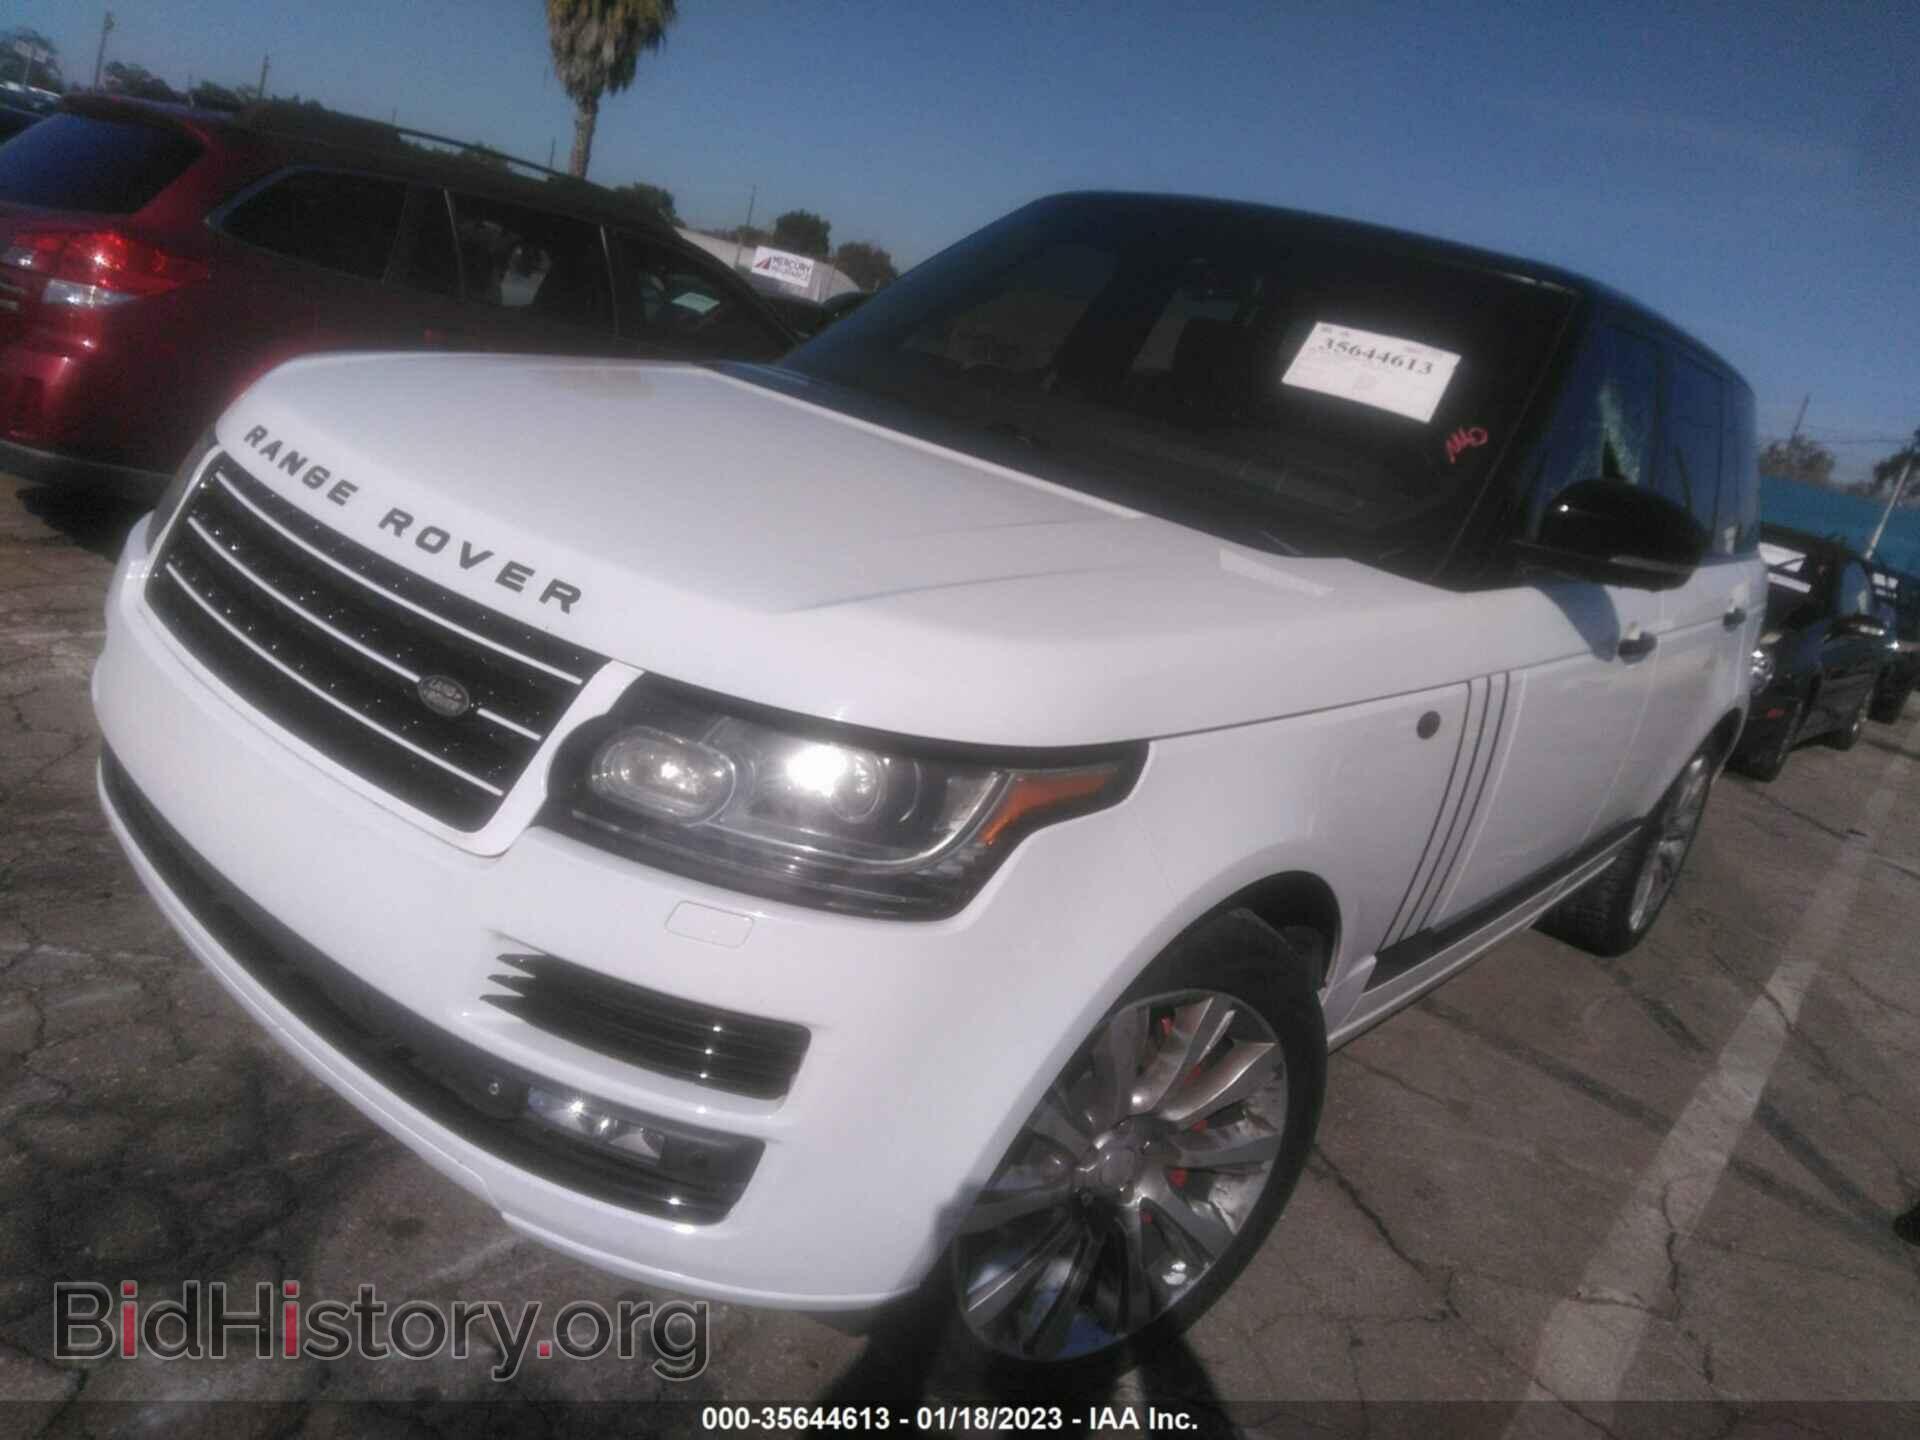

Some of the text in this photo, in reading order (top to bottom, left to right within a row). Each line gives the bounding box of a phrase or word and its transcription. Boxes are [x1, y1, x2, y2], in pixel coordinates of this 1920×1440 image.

[1318, 336, 1434, 376] 35644613
[243, 424, 583, 615] RANGE ROVER
